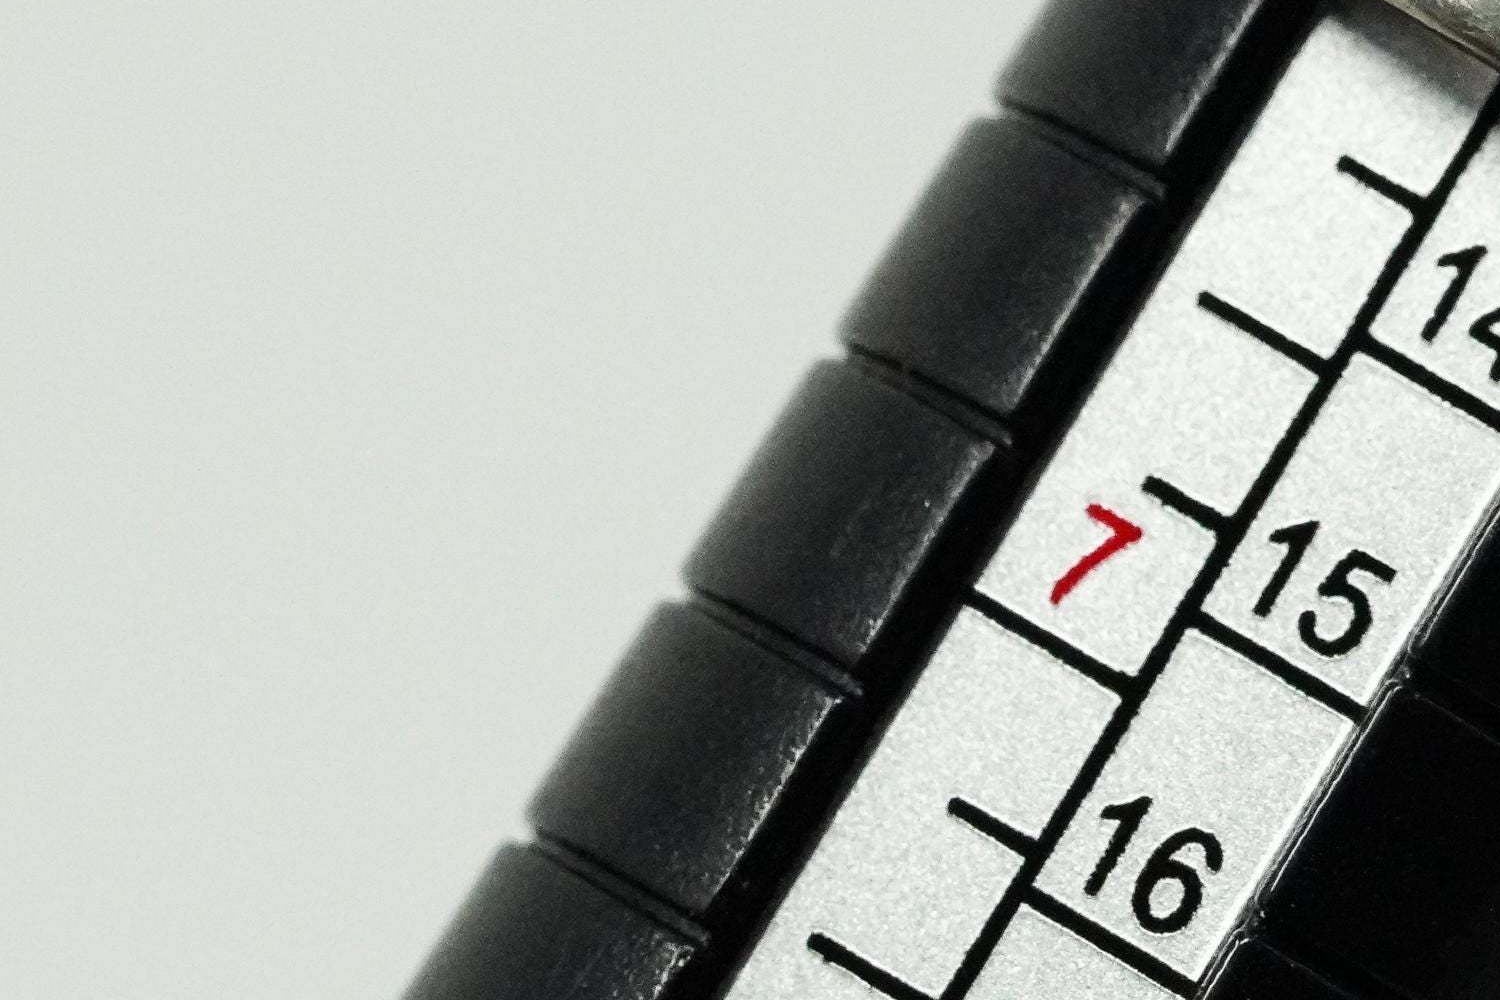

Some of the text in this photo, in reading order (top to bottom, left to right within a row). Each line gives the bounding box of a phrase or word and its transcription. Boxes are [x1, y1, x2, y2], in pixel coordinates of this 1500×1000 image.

[1049, 503, 1144, 606] 7
[1251, 519, 1399, 659] 15
[1082, 795, 1225, 936] 16
